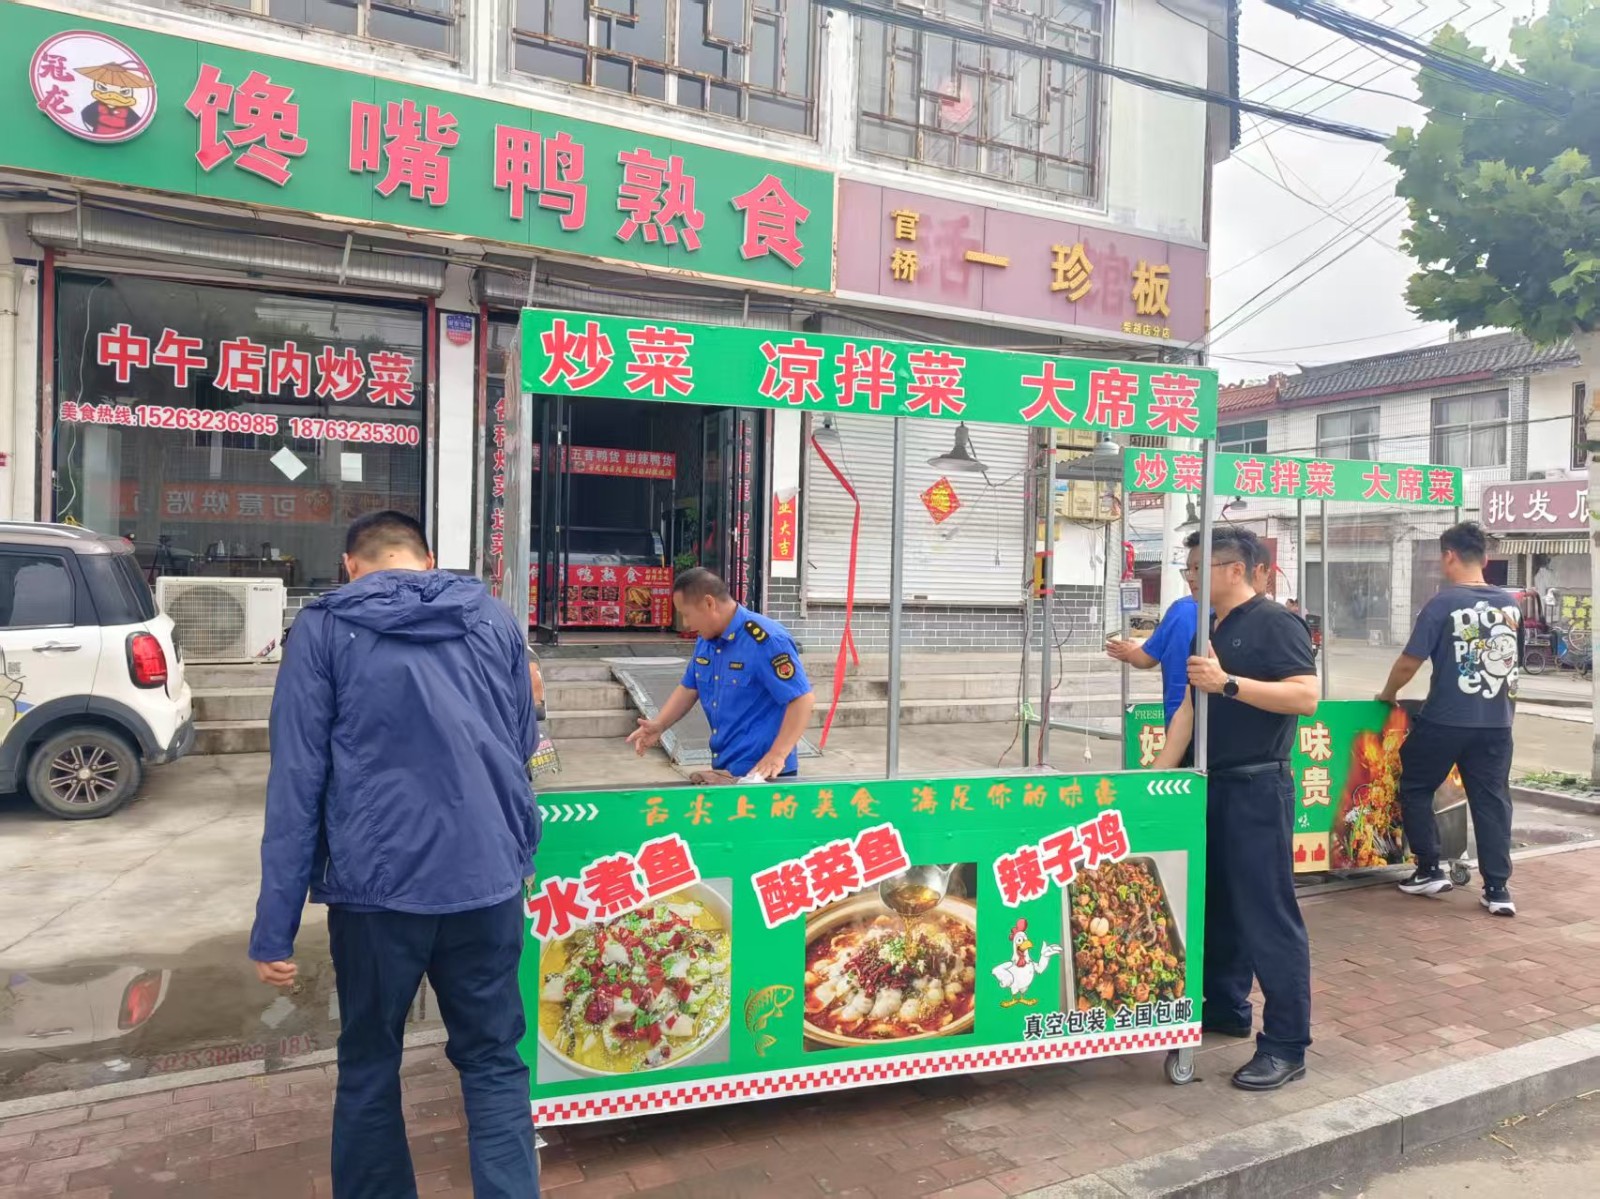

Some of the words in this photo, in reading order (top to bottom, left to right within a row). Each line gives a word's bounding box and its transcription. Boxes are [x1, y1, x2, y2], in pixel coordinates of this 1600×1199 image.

[184, 63, 812, 269] 馋嘴鸭熟食
[890, 208, 920, 283] 官桥
[964, 242, 1171, 317] 一珍板
[97, 323, 416, 406] 中午店内炒菜
[539, 319, 696, 397] 炒菜
[758, 337, 967, 416] 凉拌菜
[1020, 362, 1202, 434] 大席菜
[288, 416, 420, 446] 18763235300
[1133, 452, 1203, 490] 炒菜
[1233, 458, 1336, 498] 凉拌菜
[1362, 464, 1455, 503] 大席菜
[640, 787, 880, 827] 舌尖上的美食
[911, 777, 1118, 815] 满足你的味蕾
[1301, 766, 1332, 807] 贵
[526, 832, 701, 942] 水煮鱼
[751, 822, 911, 929] 酸菜鱼
[991, 808, 1131, 909] 辣子鸡
[1024, 1008, 1106, 1040] 真空包装
[1114, 999, 1194, 1030] 全国包邮
